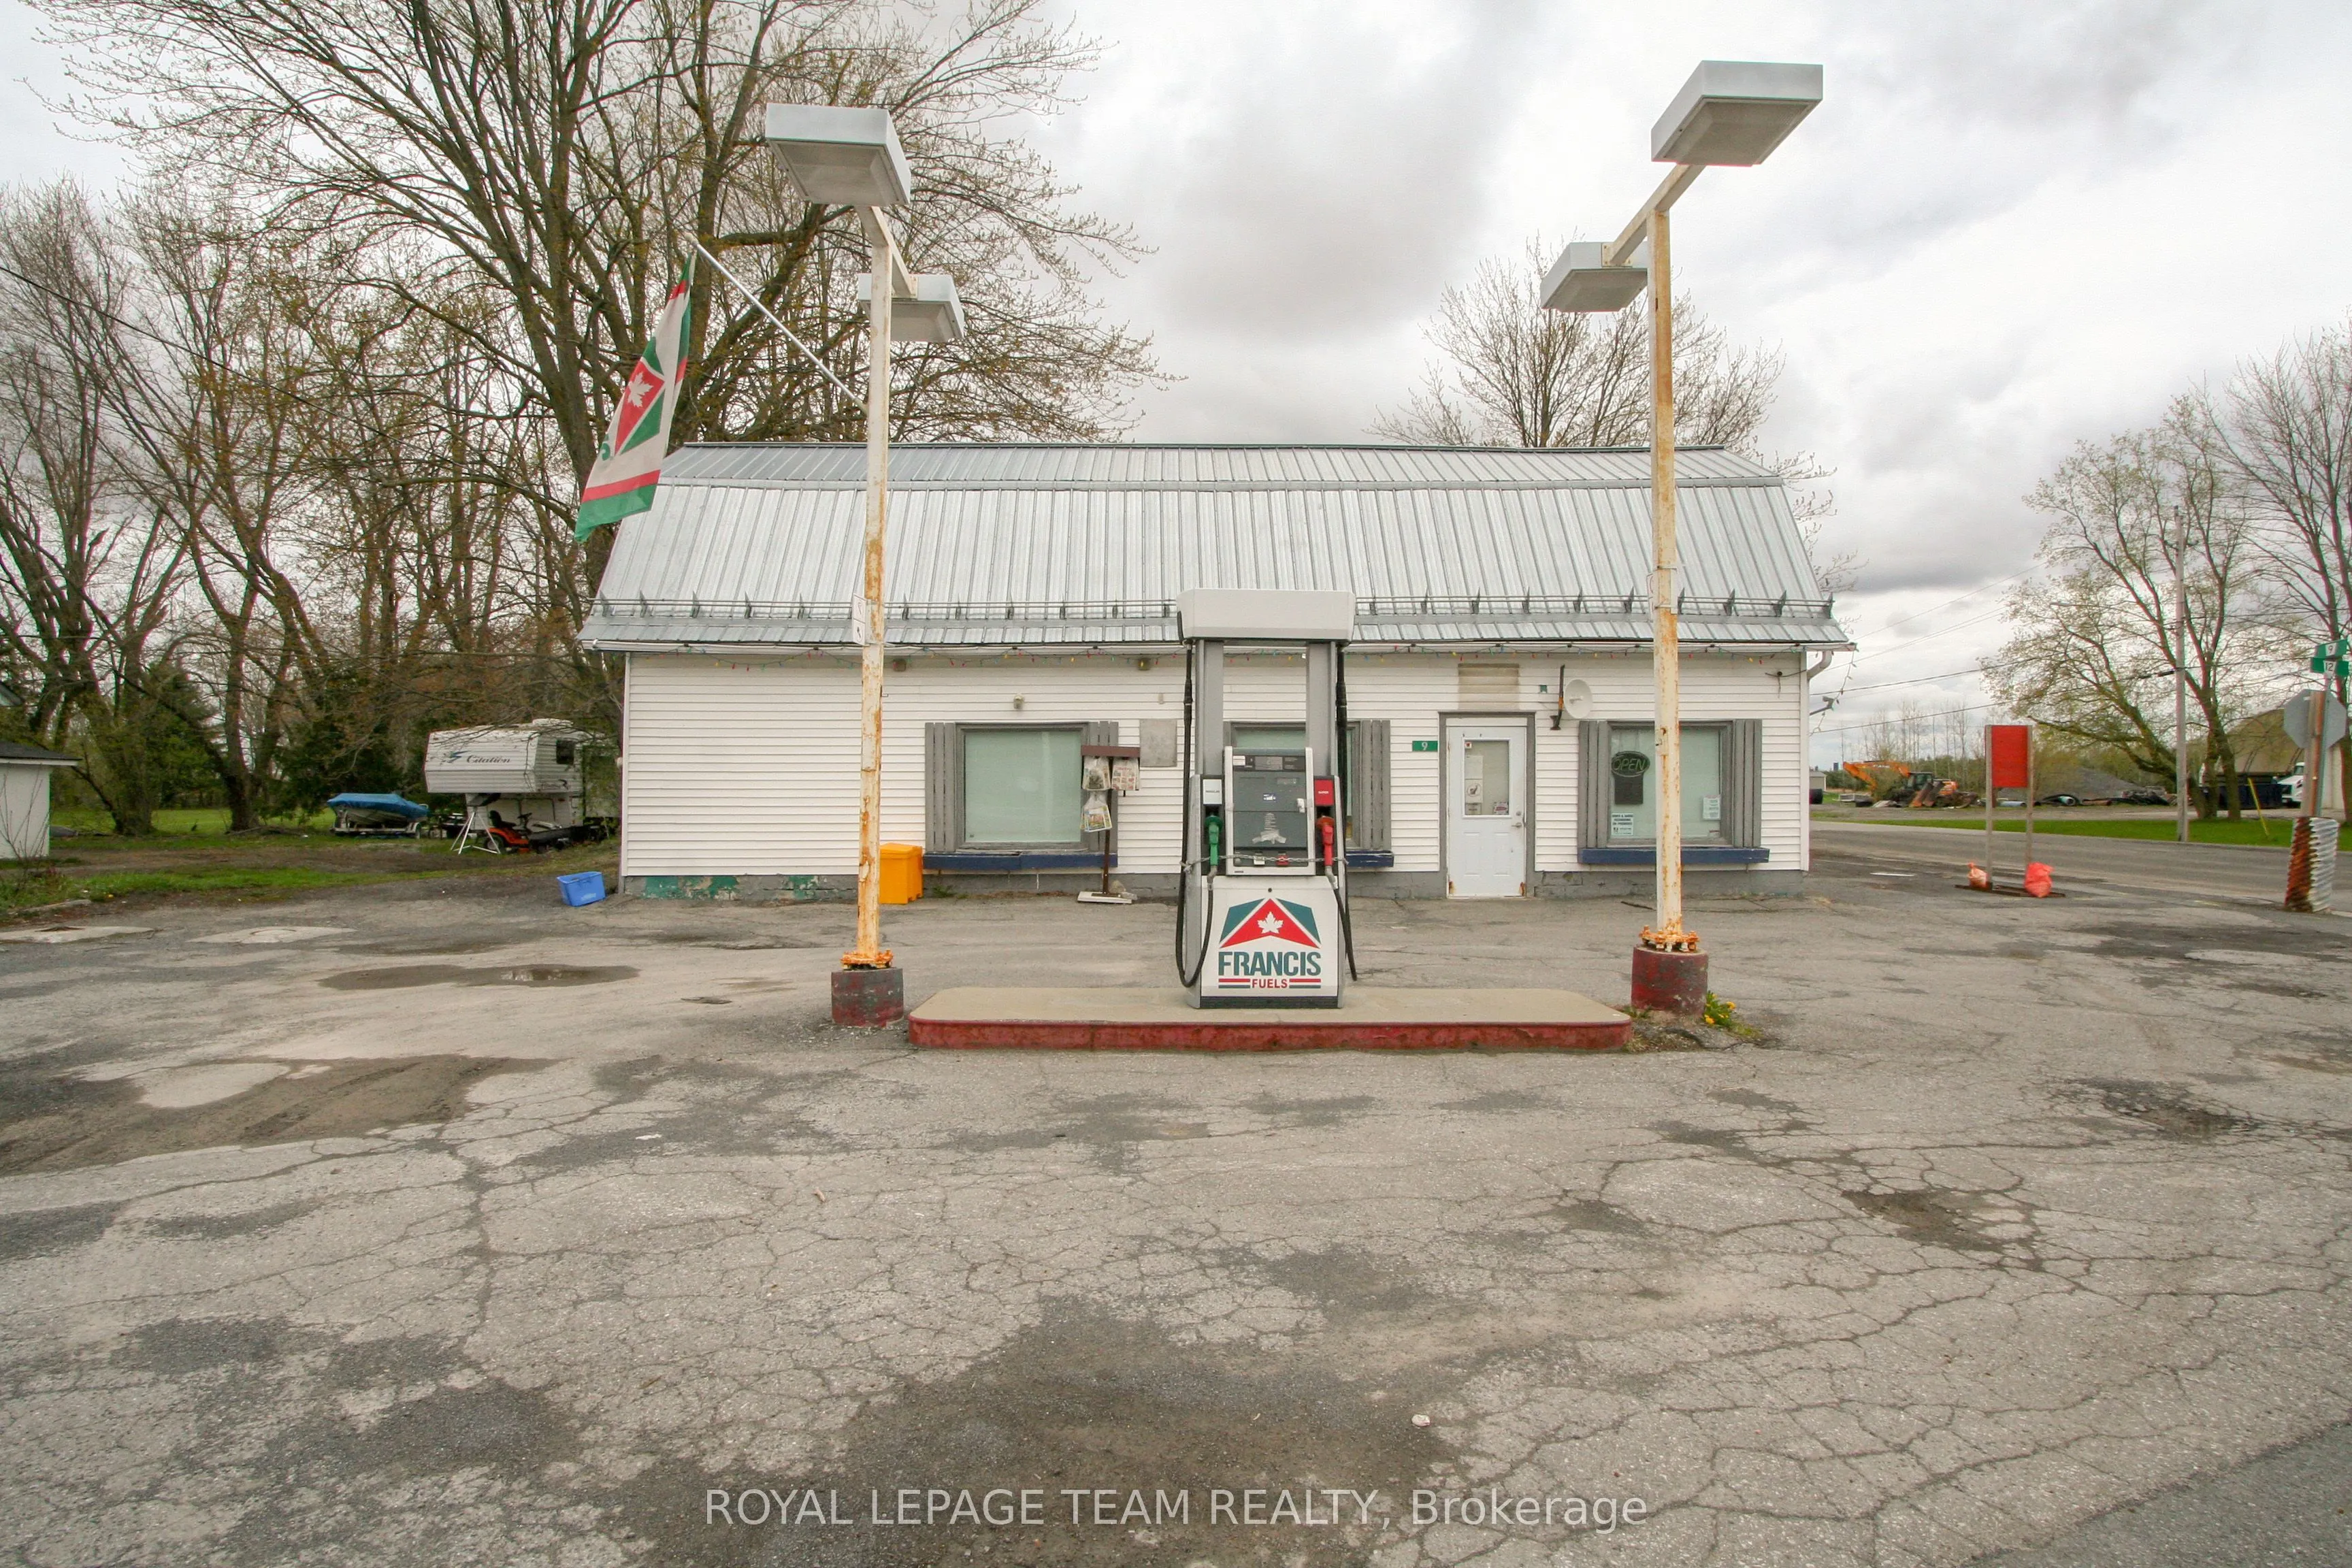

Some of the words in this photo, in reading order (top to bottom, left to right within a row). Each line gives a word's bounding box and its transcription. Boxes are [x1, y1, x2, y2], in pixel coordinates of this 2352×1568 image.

[2328, 645, 2334, 654] 9
[2325, 663, 2334, 672] 12
[1422, 742, 1428, 751] 9
[1612, 758, 1646, 771] OPEN
[1218, 951, 1322, 977] FRANCIS
[1252, 979, 1288, 989] FUELS
